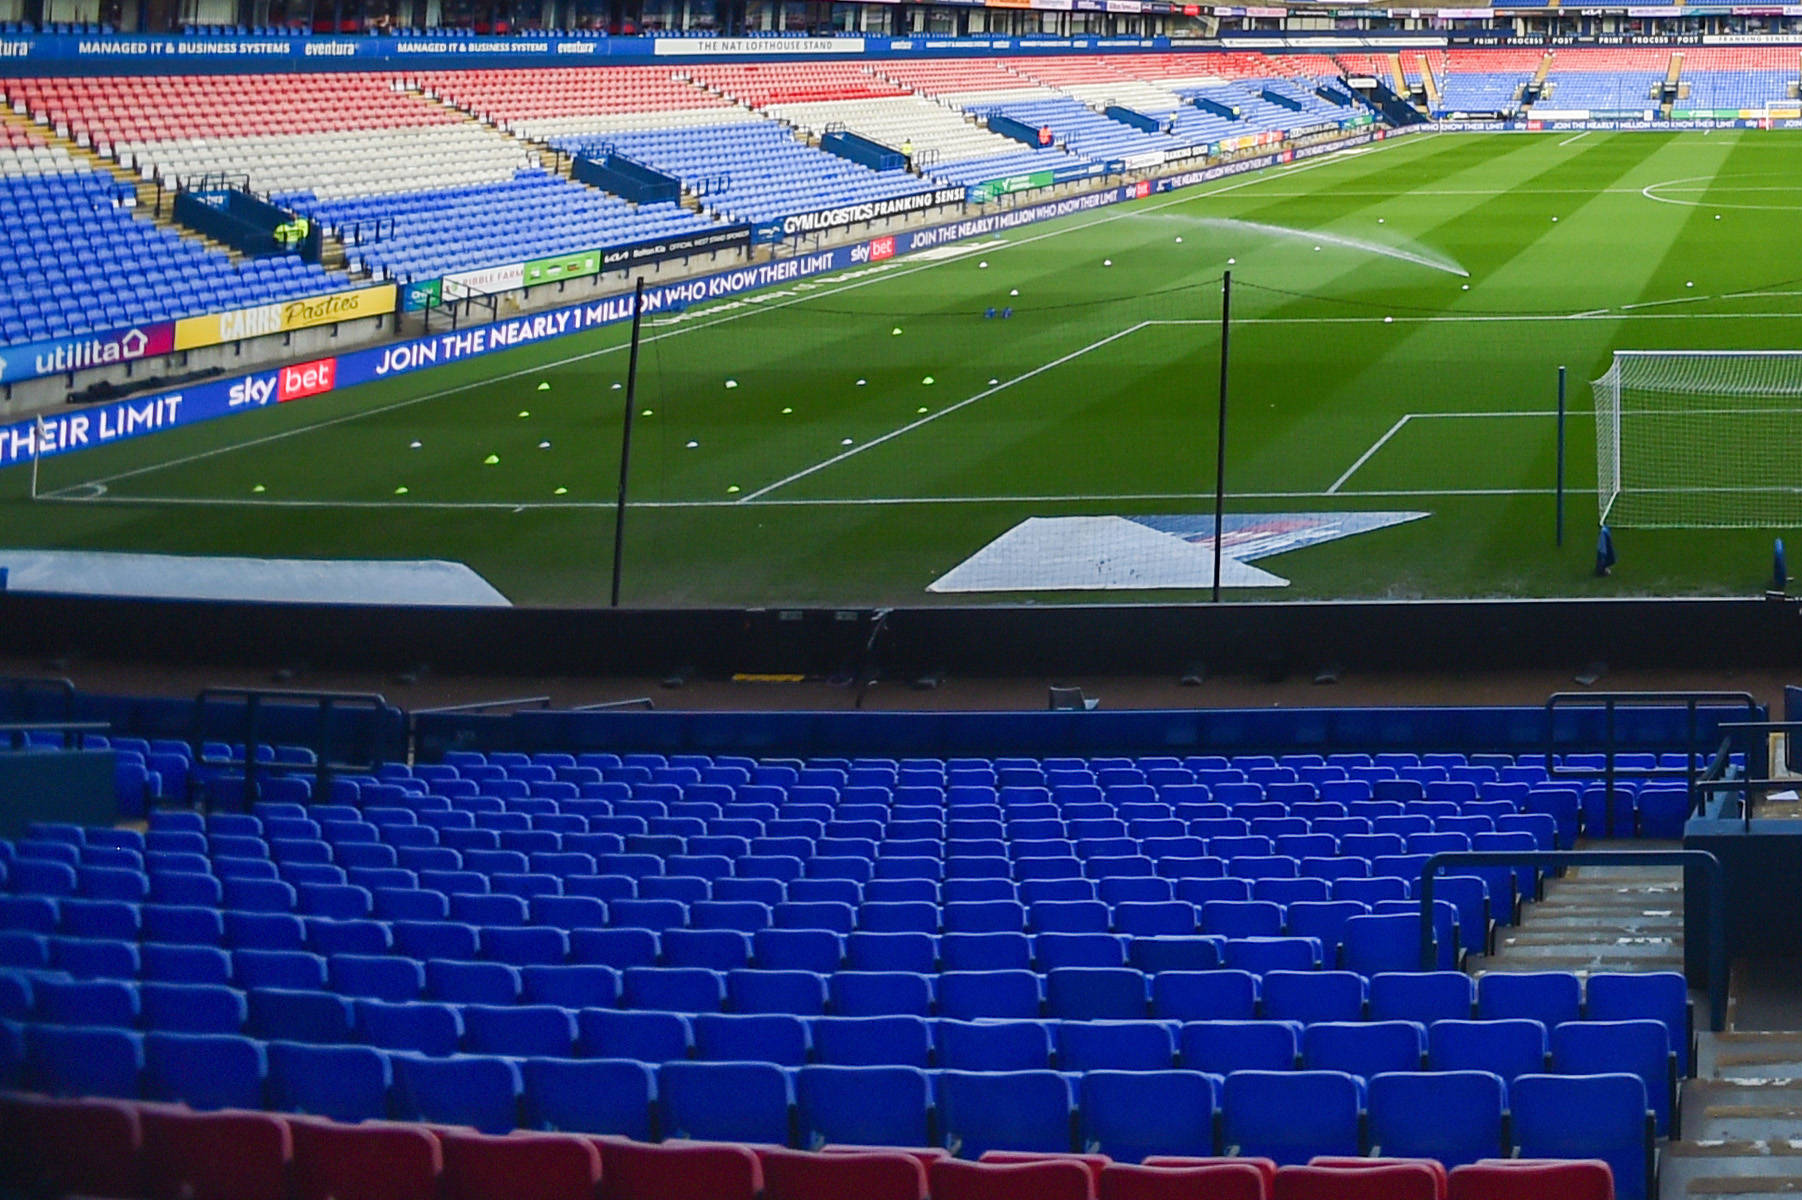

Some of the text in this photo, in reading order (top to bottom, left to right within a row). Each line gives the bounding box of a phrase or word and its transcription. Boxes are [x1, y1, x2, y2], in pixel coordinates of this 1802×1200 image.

[79, 42, 291, 55] MANAGED IT & BUSINESS SYSTEMS
[397, 42, 549, 53] MANAGED IT & BUSINESS SYSTEMS
[698, 40, 833, 51] THE NAT LOFTHOUSE STAND
[1473, 36, 1574, 45] PRINT PROCESS POST
[1598, 36, 1699, 44] PRINT PROCESS POST
[874, 189, 932, 217] FRANKING
[935, 186, 965, 204] SENSE
[910, 231, 936, 250] JOIN
[937, 226, 956, 242] THE
[958, 217, 992, 240] NEARLY
[1000, 208, 1035, 229] MILLION
[1035, 203, 1057, 220] WHO
[1101, 189, 1119, 206] LIMIT
[850, 237, 893, 264] sky bet
[219, 294, 359, 341] CARRS Pasties
[375, 336, 437, 375] JOIN
[443, 328, 485, 358] THE
[488, 311, 570, 350] NEARLY
[573, 308, 582, 330] 1
[664, 285, 706, 308] WHO
[708, 272, 753, 297] KNOW
[750, 262, 798, 287] THEIR
[799, 251, 835, 276] LIMIT
[35, 337, 121, 375] utilita
[228, 362, 330, 407] sky bet
[99, 395, 184, 440] LIMIT
